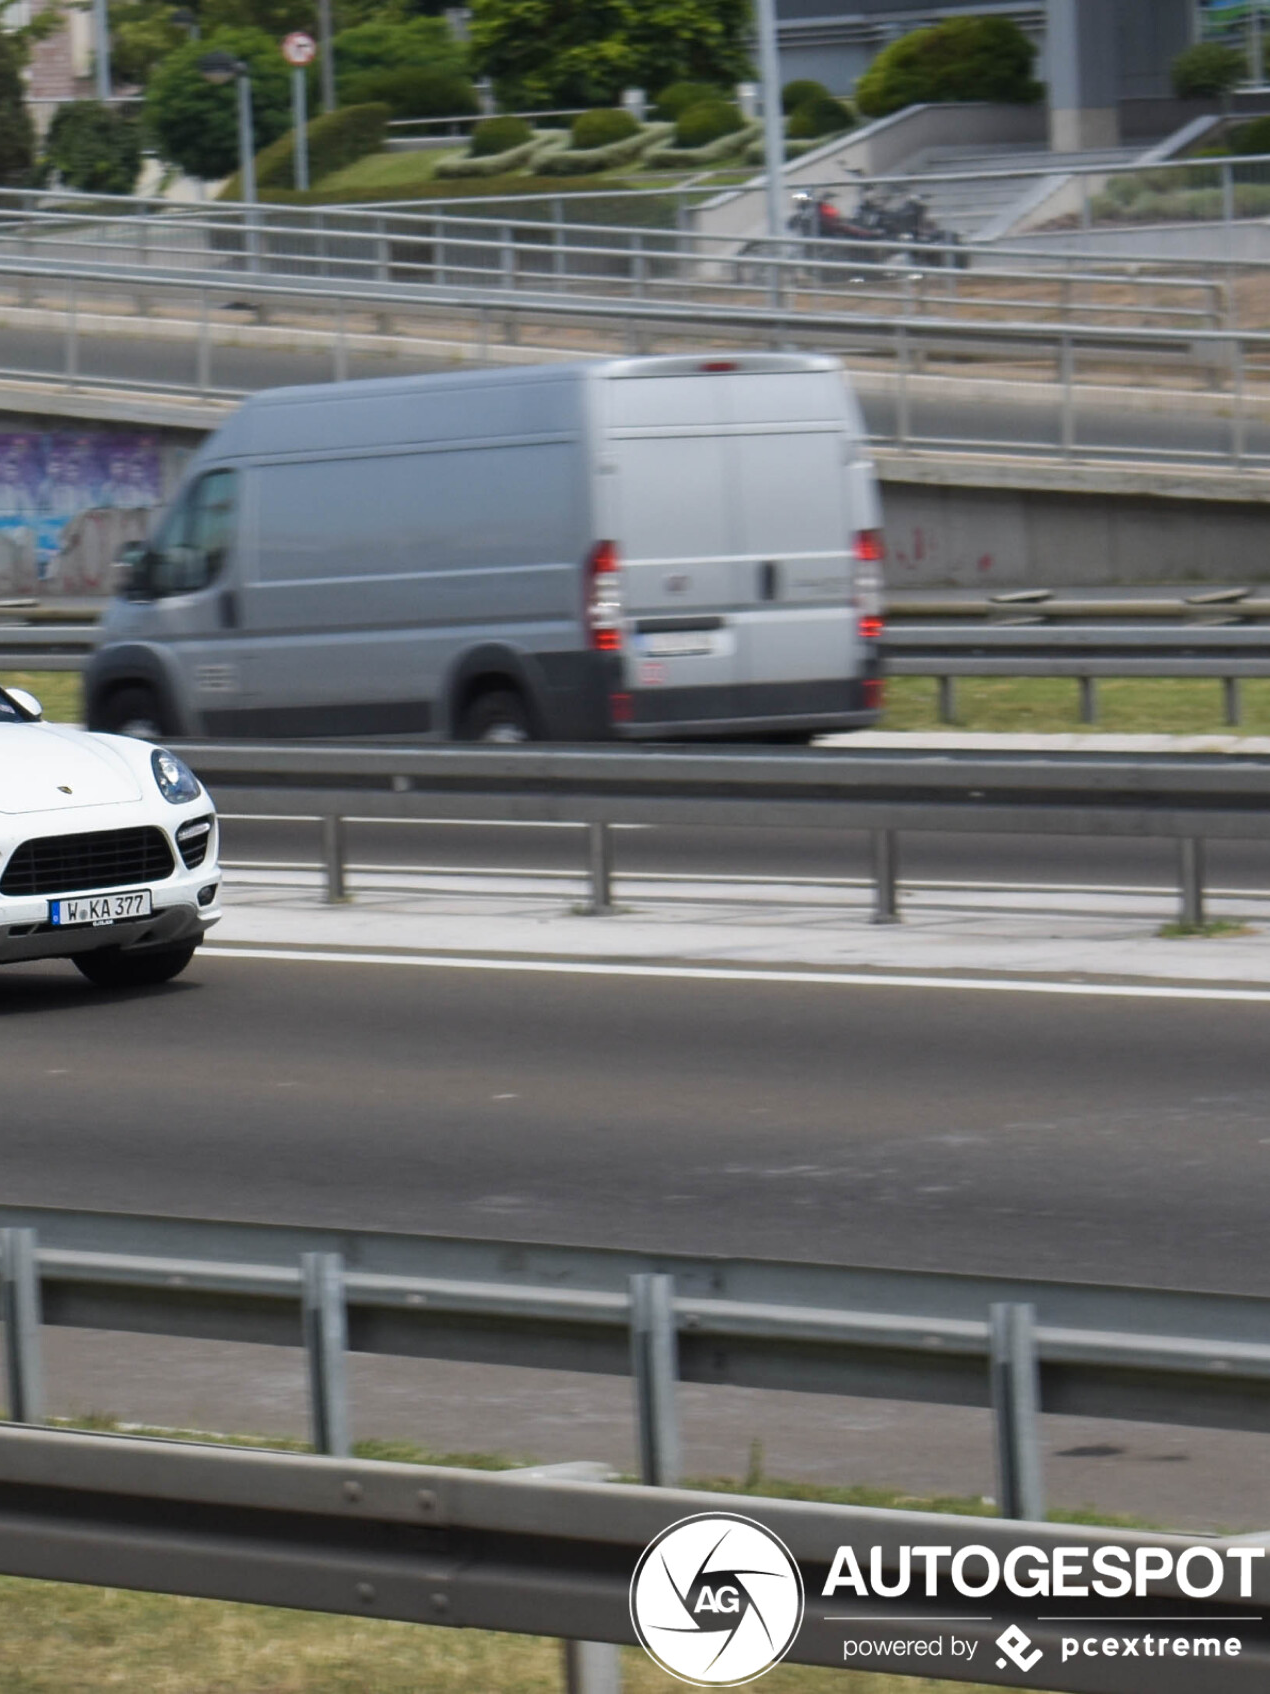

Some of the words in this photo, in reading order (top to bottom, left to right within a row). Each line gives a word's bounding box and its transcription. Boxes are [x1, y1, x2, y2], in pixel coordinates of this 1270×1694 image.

[67, 902, 79, 921] W
[89, 898, 111, 919] KA
[115, 894, 144, 916] 377
